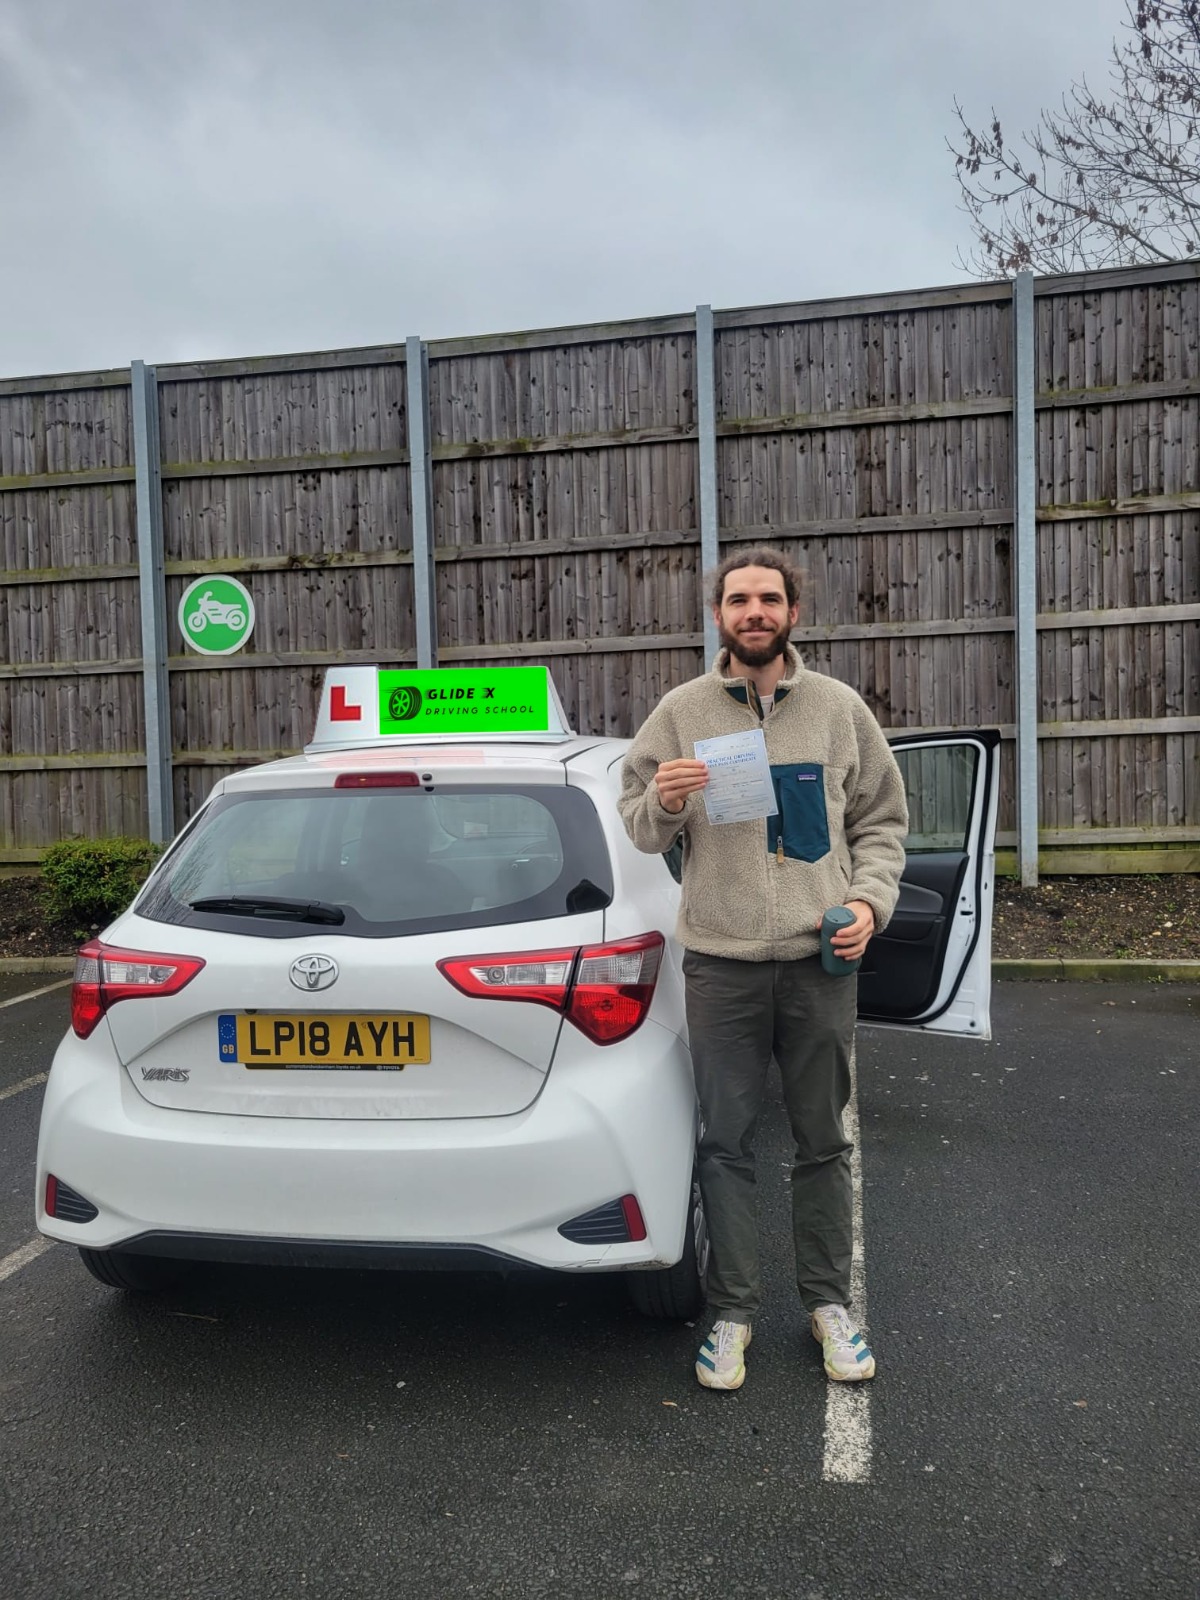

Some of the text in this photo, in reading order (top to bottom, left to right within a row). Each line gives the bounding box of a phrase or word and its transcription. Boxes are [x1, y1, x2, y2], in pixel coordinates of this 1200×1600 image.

[426, 687, 496, 700] GLIDE X
[330, 686, 362, 721] L
[425, 705, 534, 715] DRIVING SCHOOL
[250, 1021, 415, 1056] LP18 AYH
[222, 1044, 235, 1054] GB
